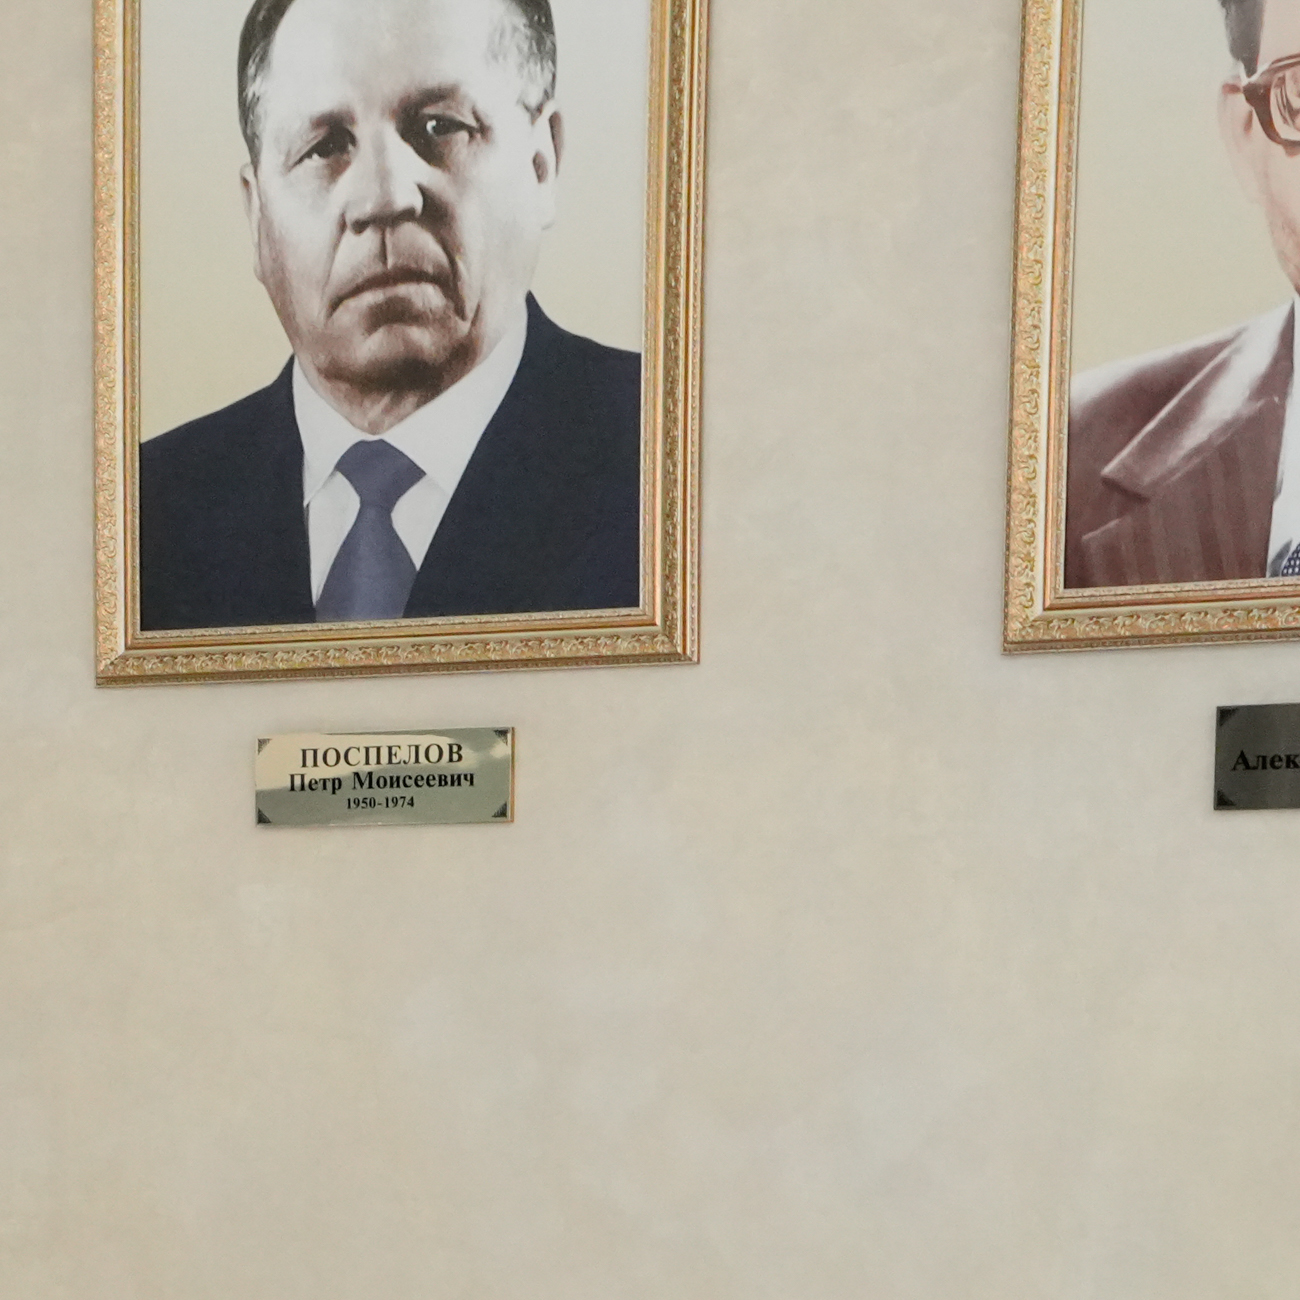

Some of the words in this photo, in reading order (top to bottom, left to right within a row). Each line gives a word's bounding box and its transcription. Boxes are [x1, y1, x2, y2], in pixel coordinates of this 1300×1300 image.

[301, 742, 463, 768] ПОСПЕЛОВ
[288, 773, 343, 795] Петр
[352, 771, 474, 790] Моисеевич
[347, 795, 415, 810] 1950-1974
